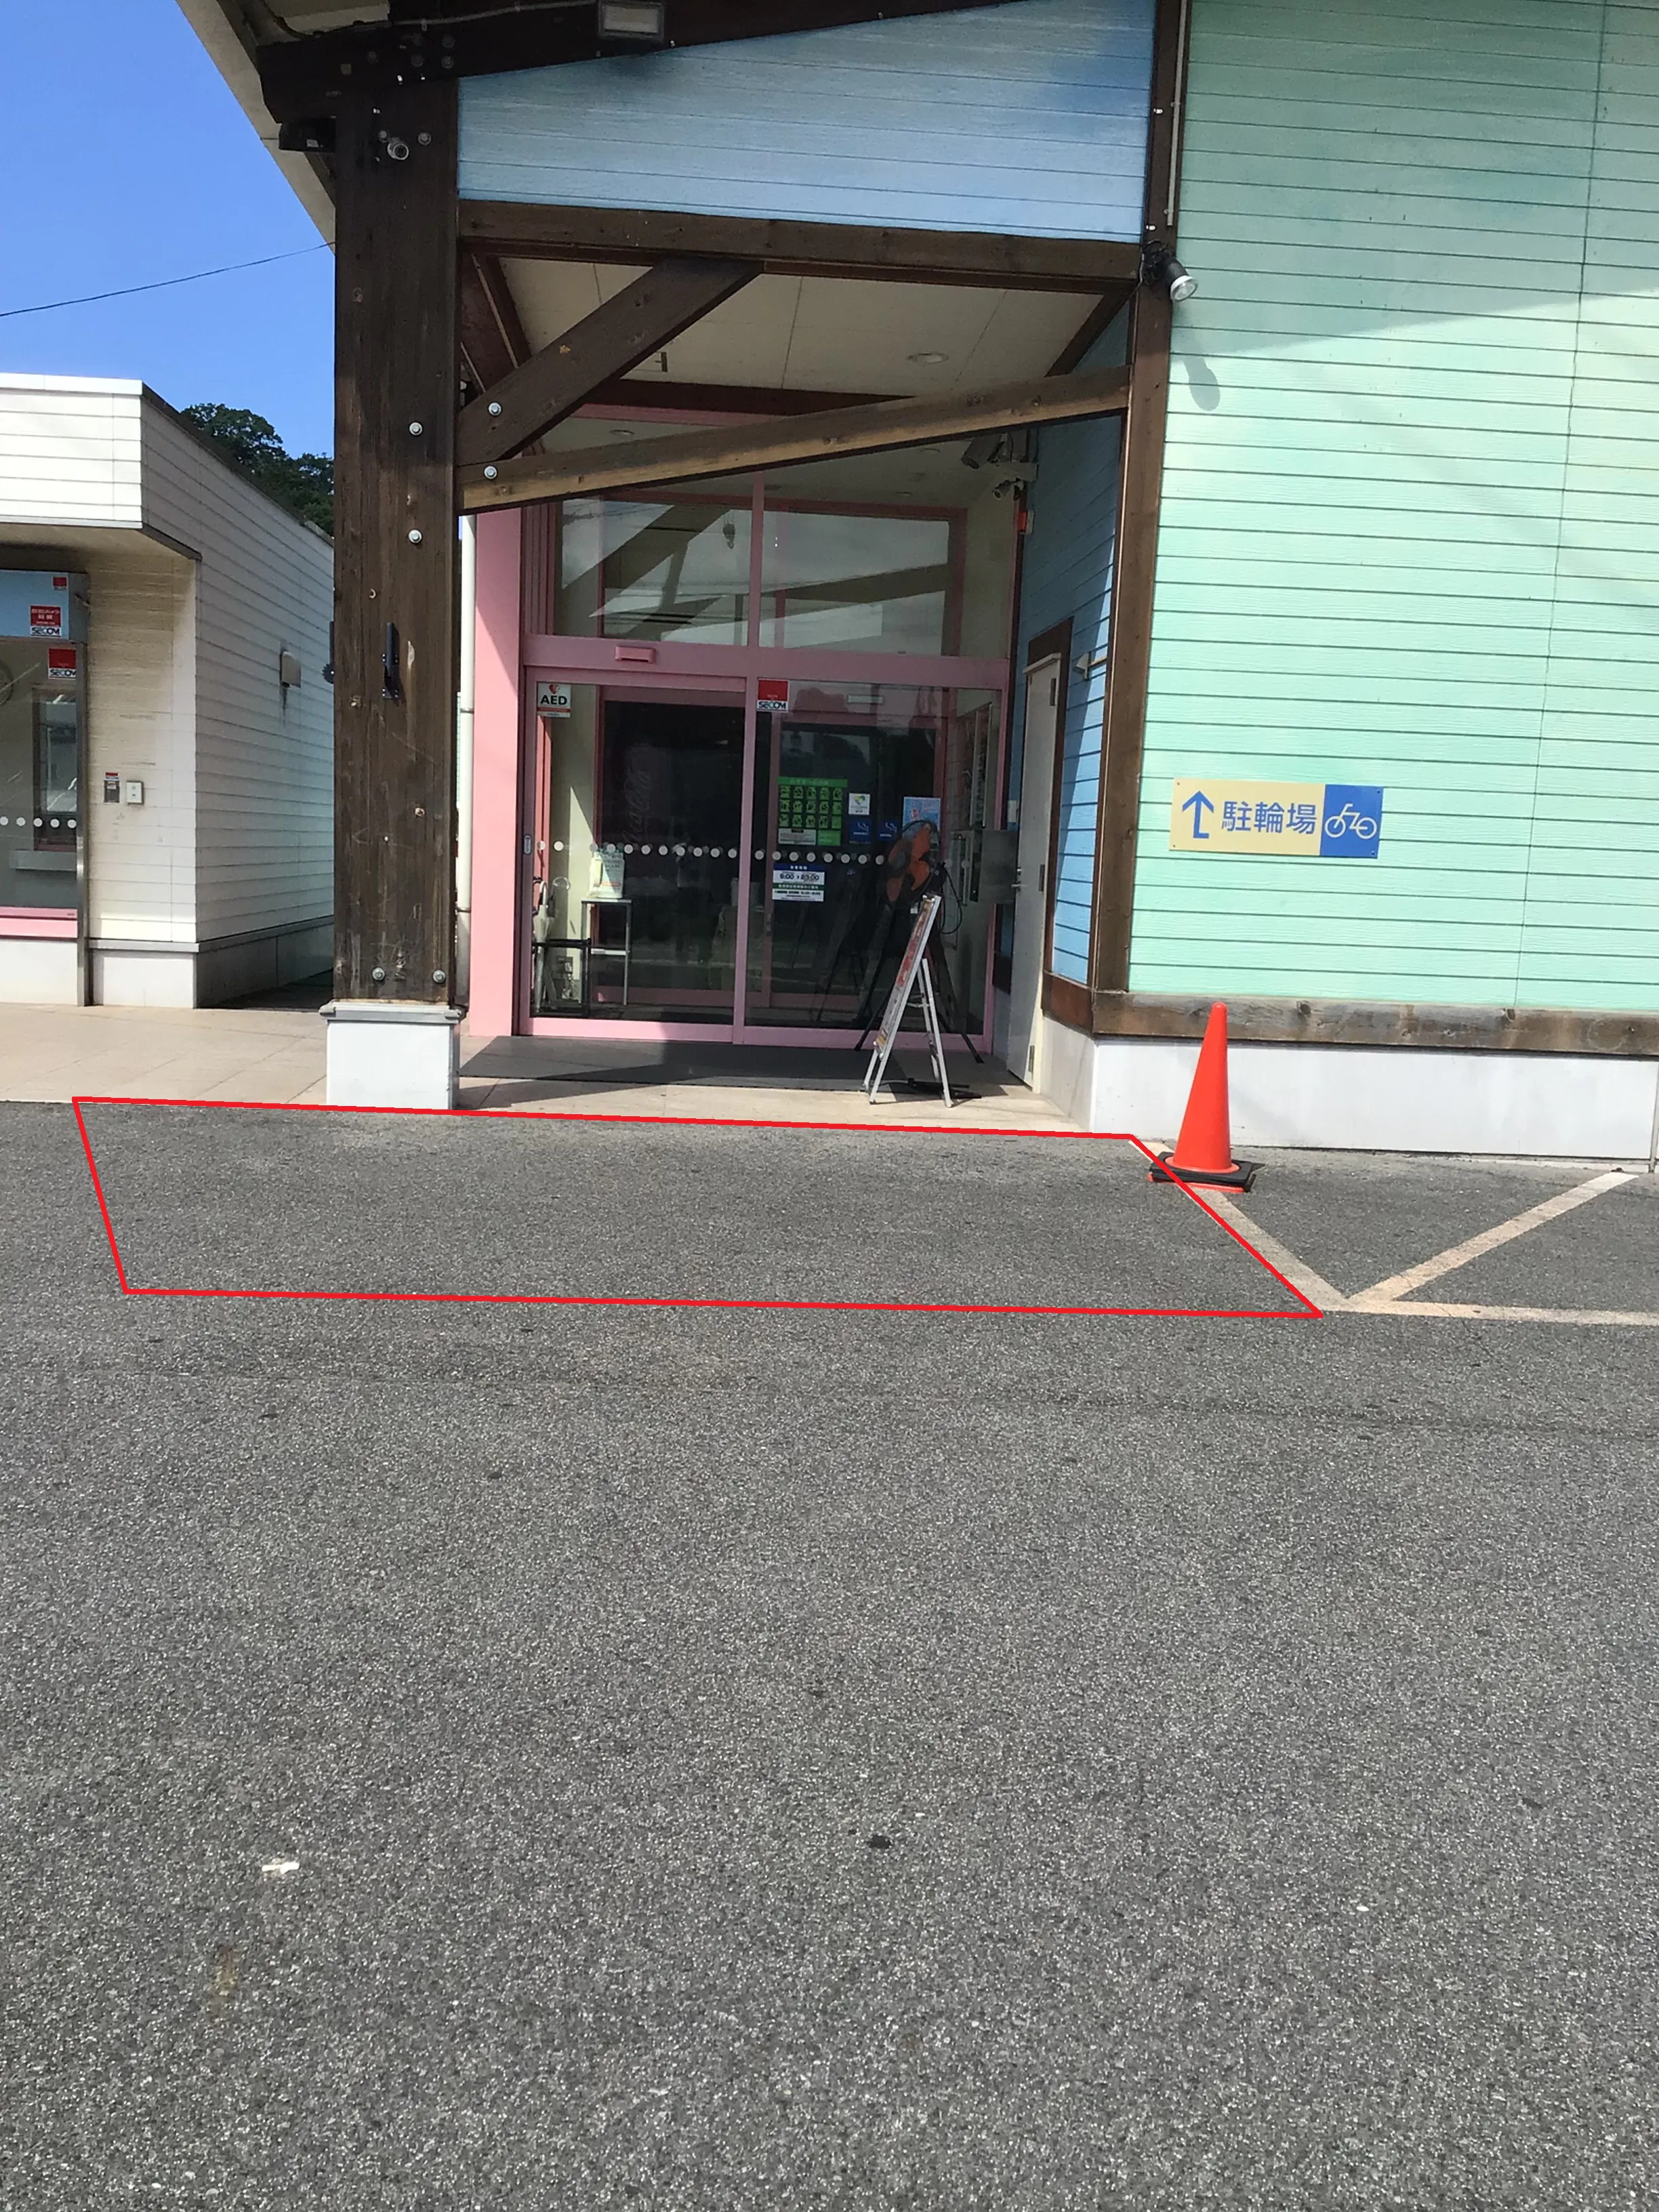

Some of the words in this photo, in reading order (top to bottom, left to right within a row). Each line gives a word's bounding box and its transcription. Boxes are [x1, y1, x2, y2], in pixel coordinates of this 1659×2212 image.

[540, 695, 568, 705] AED
[1222, 801, 1317, 834] 駐輪場
